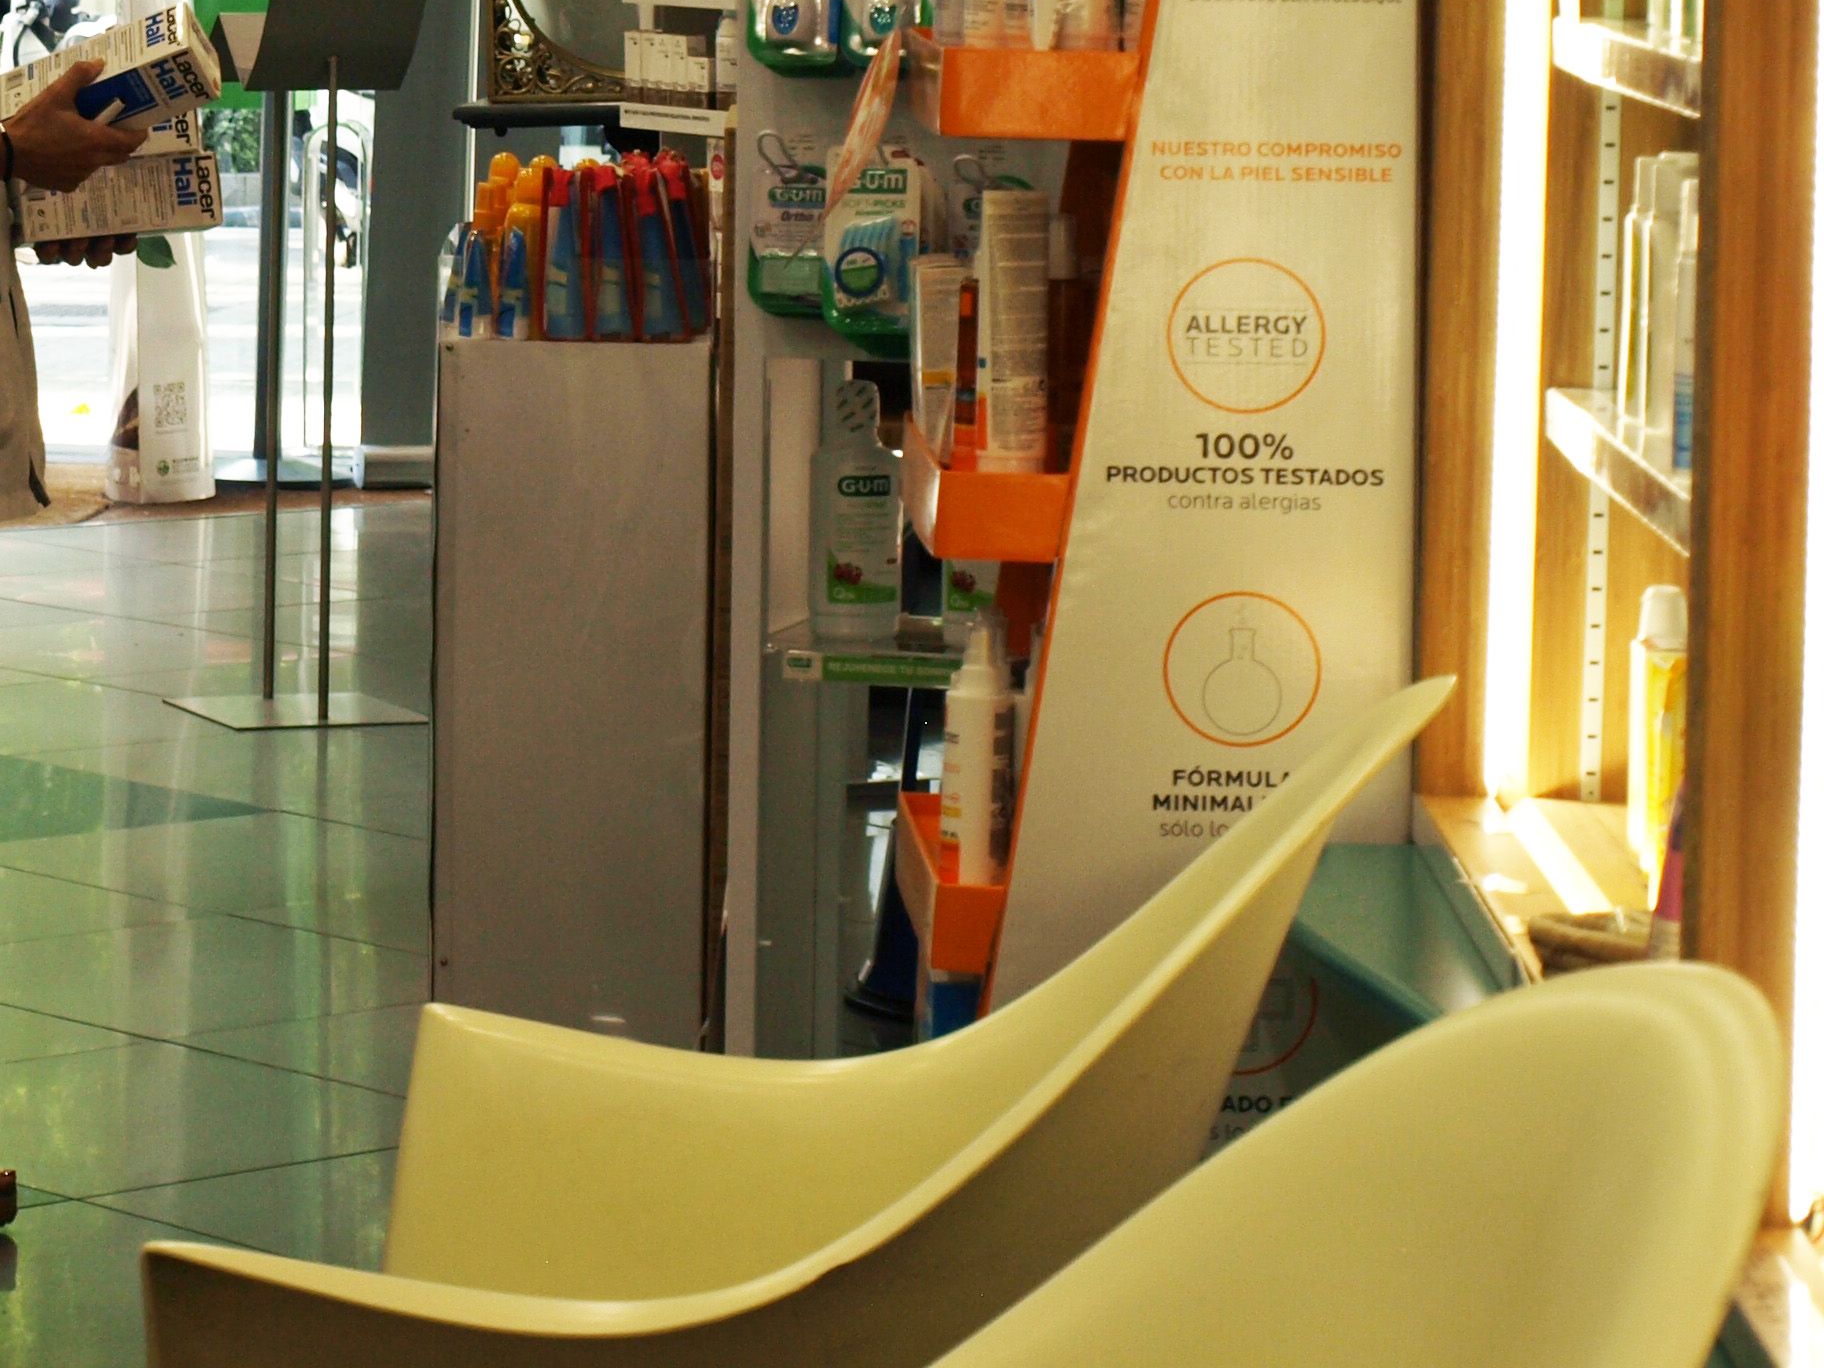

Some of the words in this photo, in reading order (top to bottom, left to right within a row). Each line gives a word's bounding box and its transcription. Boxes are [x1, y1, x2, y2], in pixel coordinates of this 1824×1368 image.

[145, 12, 165, 47] Hali
[151, 60, 189, 100] Hali
[172, 50, 210, 100] Lacer
[1151, 140, 1252, 157] NUESTRO
[1258, 141, 1402, 158] COMPROMISO
[172, 157, 197, 206] Hali
[1160, 165, 1204, 181] CON
[1210, 165, 1233, 181] LA
[1239, 166, 1285, 182] PIEL
[1291, 167, 1392, 182] SENSIBLE
[194, 155, 216, 220] Lacer
[781, 210, 813, 222] Ortho
[1186, 316, 1307, 335] ALLERGY
[1186, 337, 1308, 358] TESTED
[1195, 433, 1294, 460] 100%
[1106, 466, 1254, 485] PRODUCTOS
[1261, 468, 1384, 486] TESTADOS
[1168, 495, 1233, 510] contra
[1240, 494, 1321, 513] alergias
[1160, 820, 1204, 837] sólo
